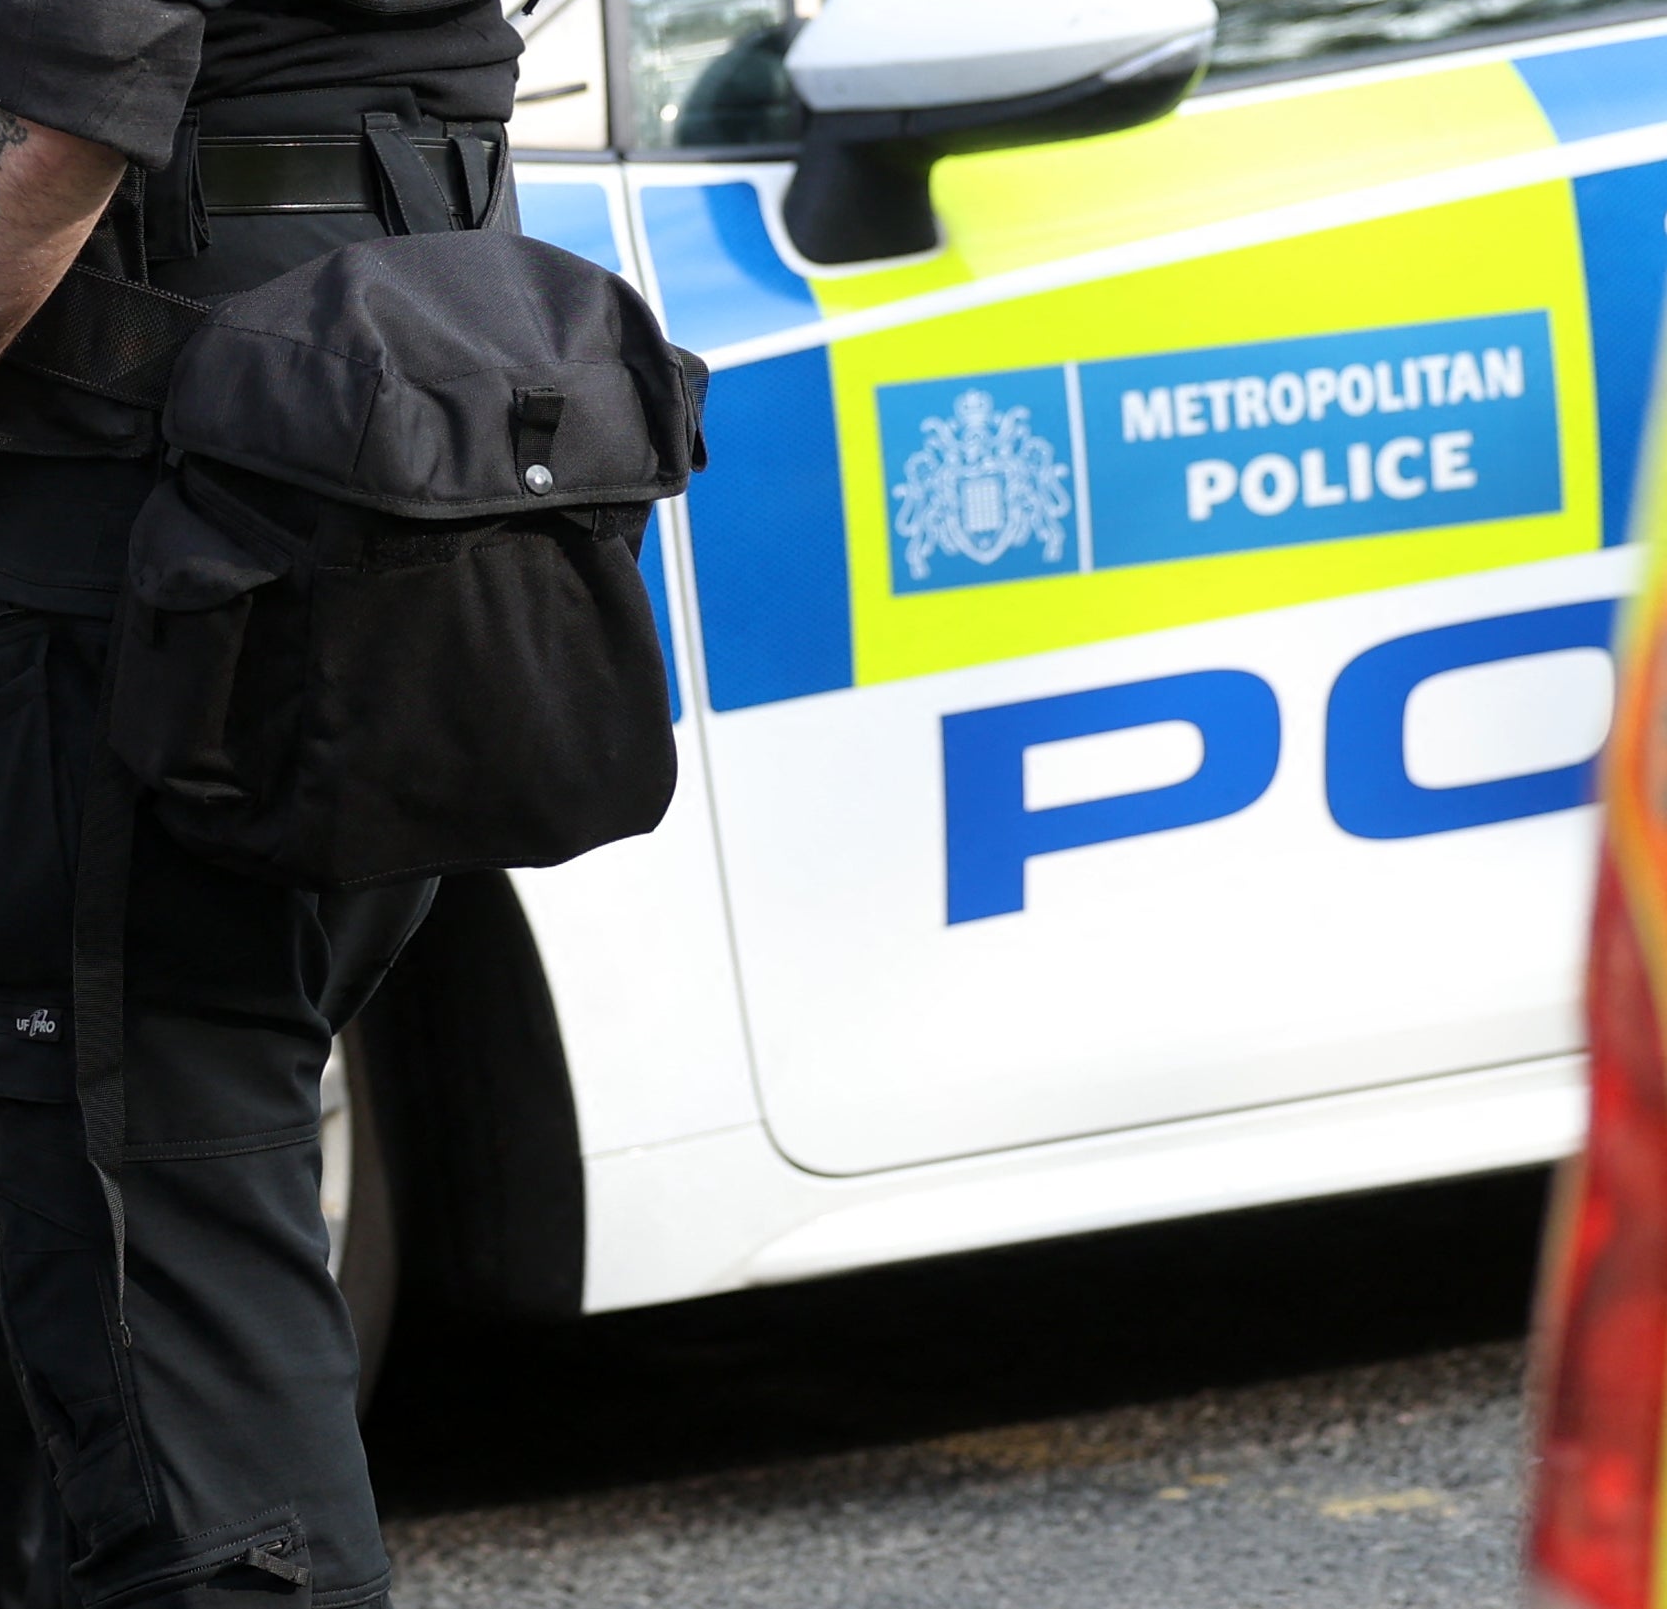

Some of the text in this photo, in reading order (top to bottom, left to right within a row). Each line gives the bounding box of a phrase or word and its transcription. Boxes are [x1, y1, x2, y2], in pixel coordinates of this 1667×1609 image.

[1120, 345, 1525, 444] METROPOLITAN
[1185, 431, 1478, 522] POLICE
[16, 1017, 31, 1032] UF
